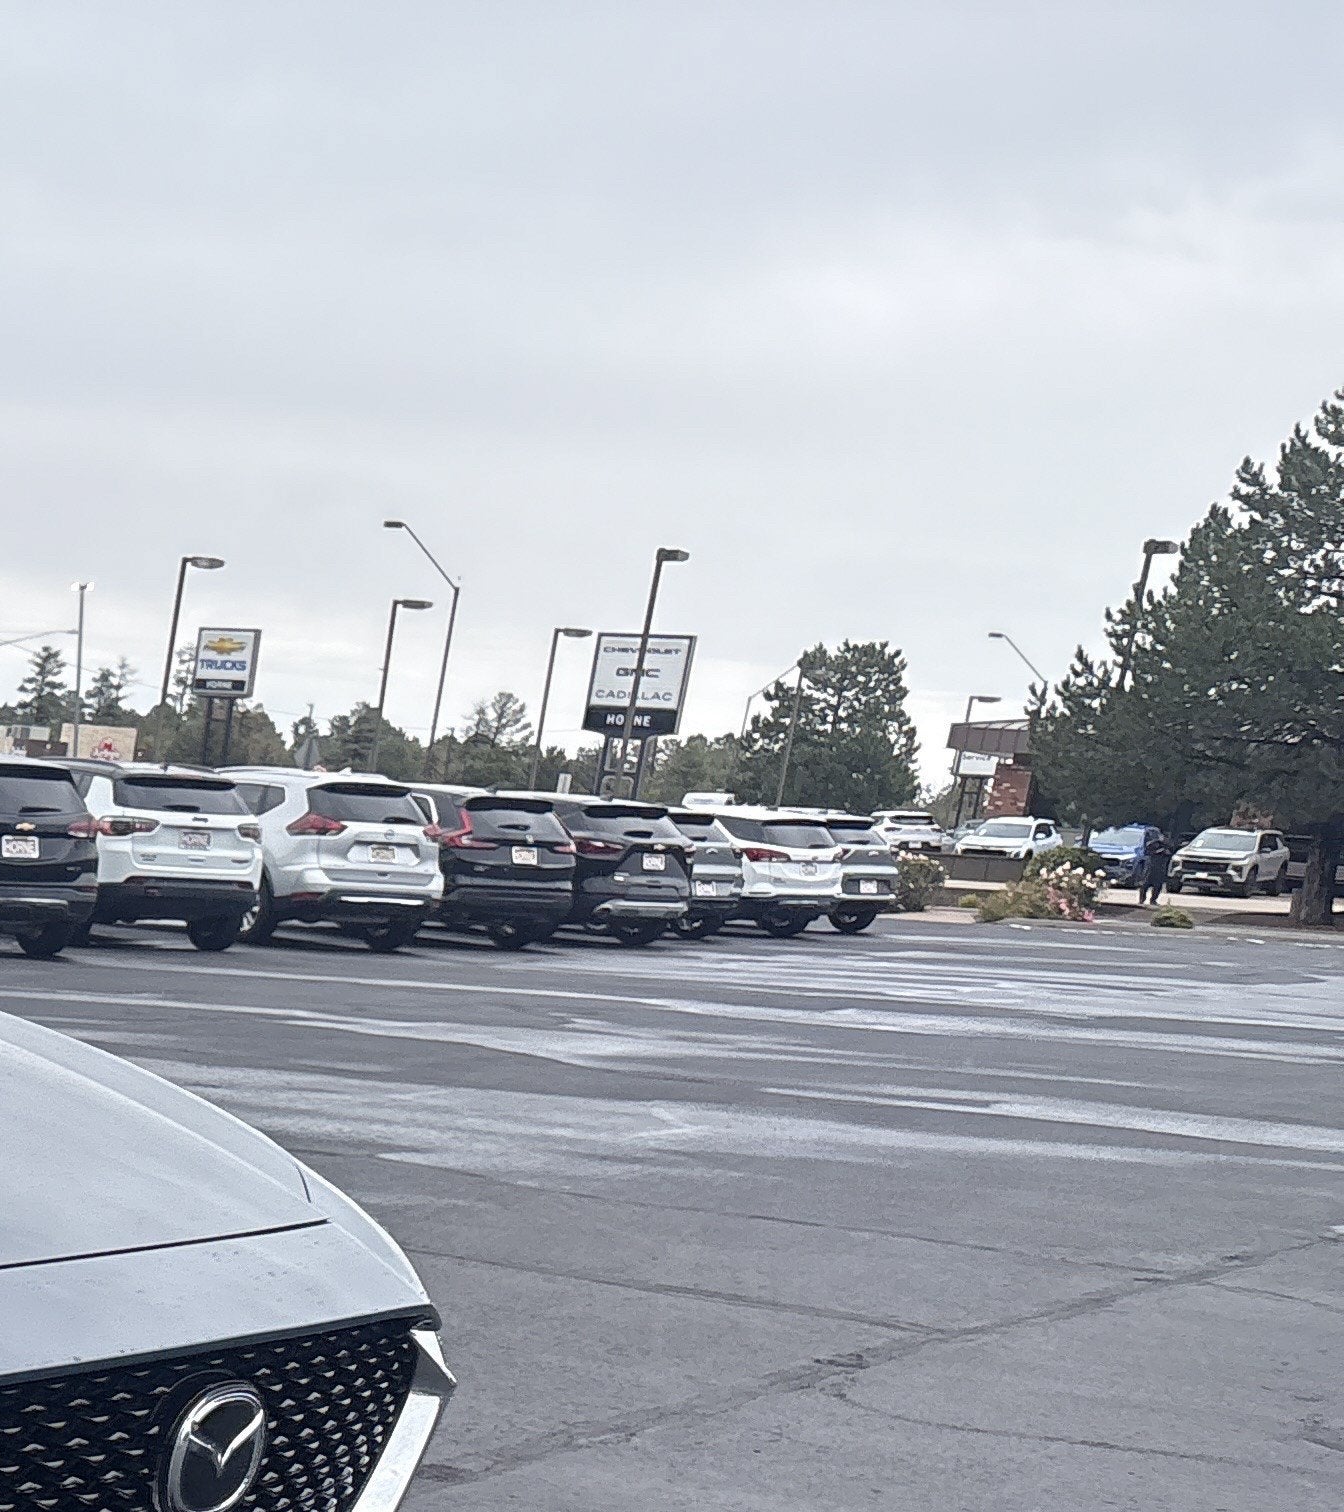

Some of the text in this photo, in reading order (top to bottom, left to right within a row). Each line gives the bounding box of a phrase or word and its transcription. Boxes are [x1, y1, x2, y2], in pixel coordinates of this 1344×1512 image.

[603, 646, 682, 655] CHEVOLET
[199, 659, 247, 671] TRUCKS
[594, 689, 673, 702] CADILAC
[605, 713, 652, 728] HONE
